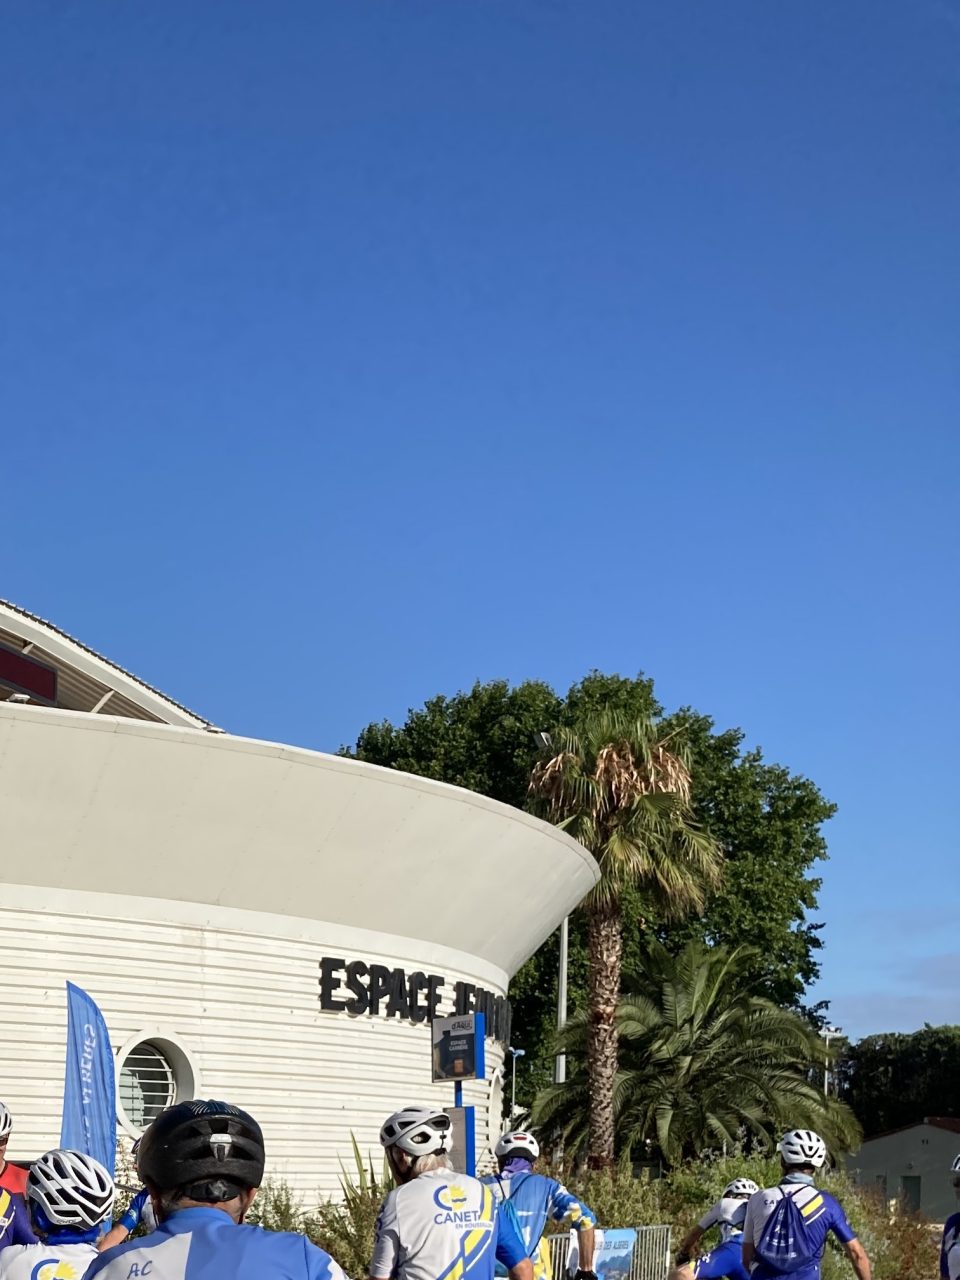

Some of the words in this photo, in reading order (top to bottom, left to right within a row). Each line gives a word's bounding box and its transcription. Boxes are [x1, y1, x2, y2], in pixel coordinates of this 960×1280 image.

[319, 957, 445, 1024] ESPACE
[434, 1210, 479, 1225] CANET
[127, 1260, 153, 1280] AC
